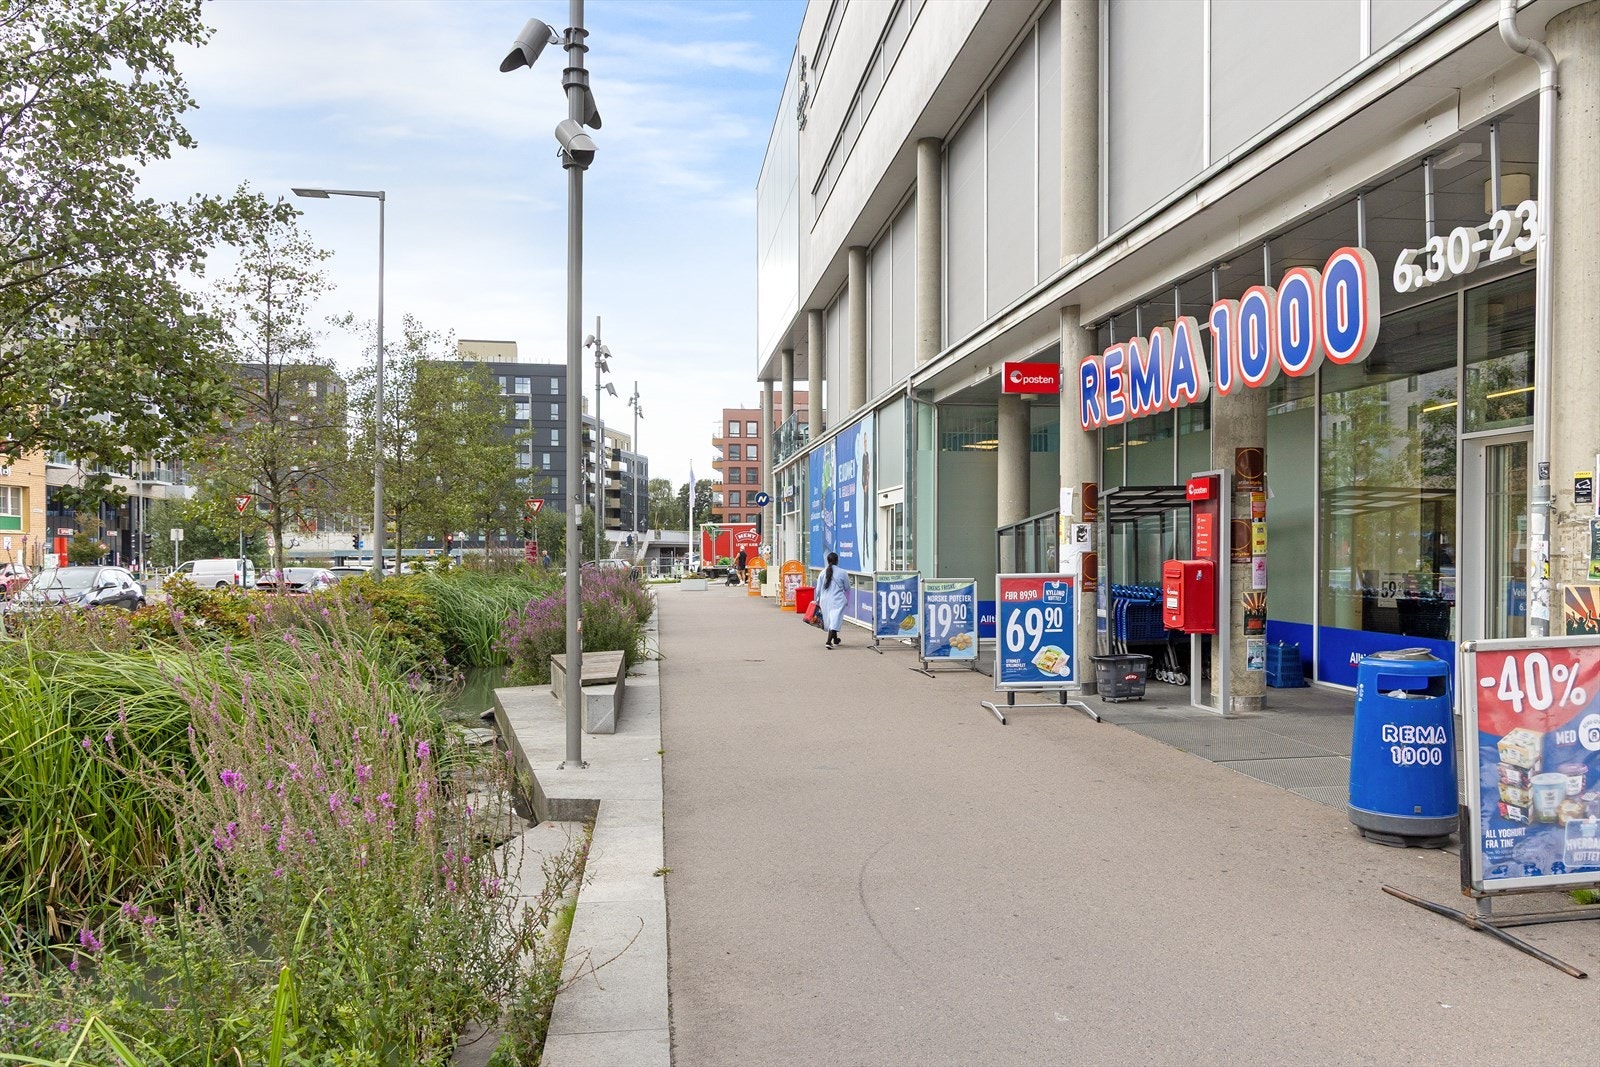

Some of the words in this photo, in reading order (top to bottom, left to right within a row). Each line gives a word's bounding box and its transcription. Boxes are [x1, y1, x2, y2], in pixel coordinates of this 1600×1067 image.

[1393, 200, 1538, 293] 6.30-23
[1080, 316, 1202, 431] REMA
[1209, 247, 1370, 396] 1000
[1023, 375, 1054, 385] posten
[927, 594, 948, 602] NORSKE
[949, 594, 972, 602] POTETER
[1005, 590, 1019, 600] FØR
[1019, 589, 1038, 601] 89,90
[1381, 581, 1396, 598] 59
[879, 591, 900, 620] 19
[901, 591, 912, 601] 90
[928, 603, 952, 638] 19
[953, 603, 967, 620] 90
[1006, 607, 1044, 652] 69
[1044, 607, 1063, 628] 90
[1480, 652, 1586, 713] -40%
[1382, 724, 1447, 744] REMA
[1555, 730, 1577, 744] MED
[1390, 745, 1442, 766] 1000
[1485, 829, 1497, 838] ALL
[1498, 827, 1526, 838] YOGHURT
[1485, 839, 1499, 849] FRA
[1500, 838, 1514, 848] TINE
